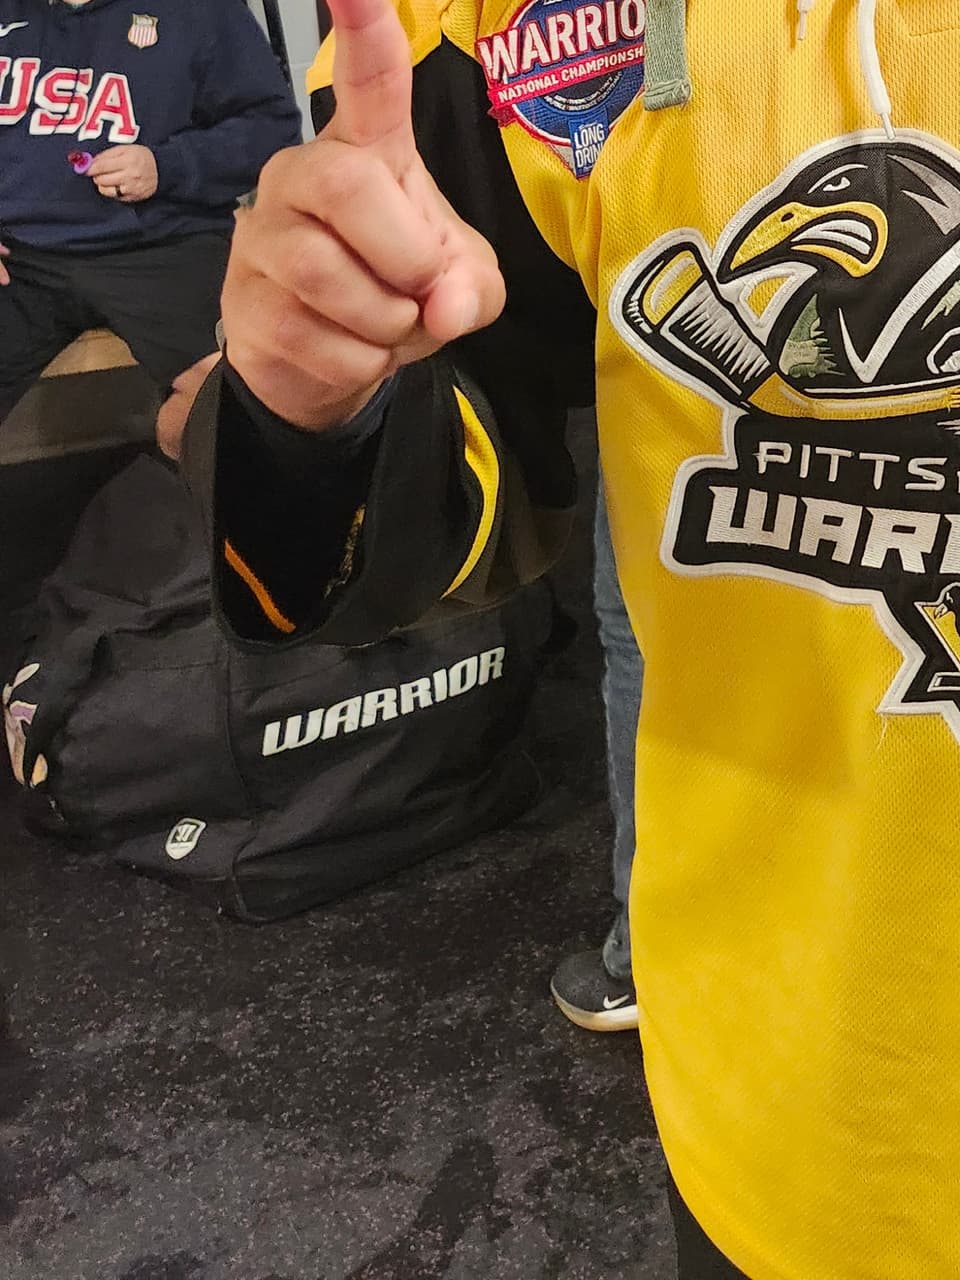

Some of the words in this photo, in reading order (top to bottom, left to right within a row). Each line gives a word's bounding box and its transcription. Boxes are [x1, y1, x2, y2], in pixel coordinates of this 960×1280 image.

[0, 56, 140, 144] USA
[498, 74, 559, 104] NATIONAL
[574, 124, 605, 149] LONG
[575, 142, 604, 168] DRIN
[262, 646, 505, 757] WARRIOR
